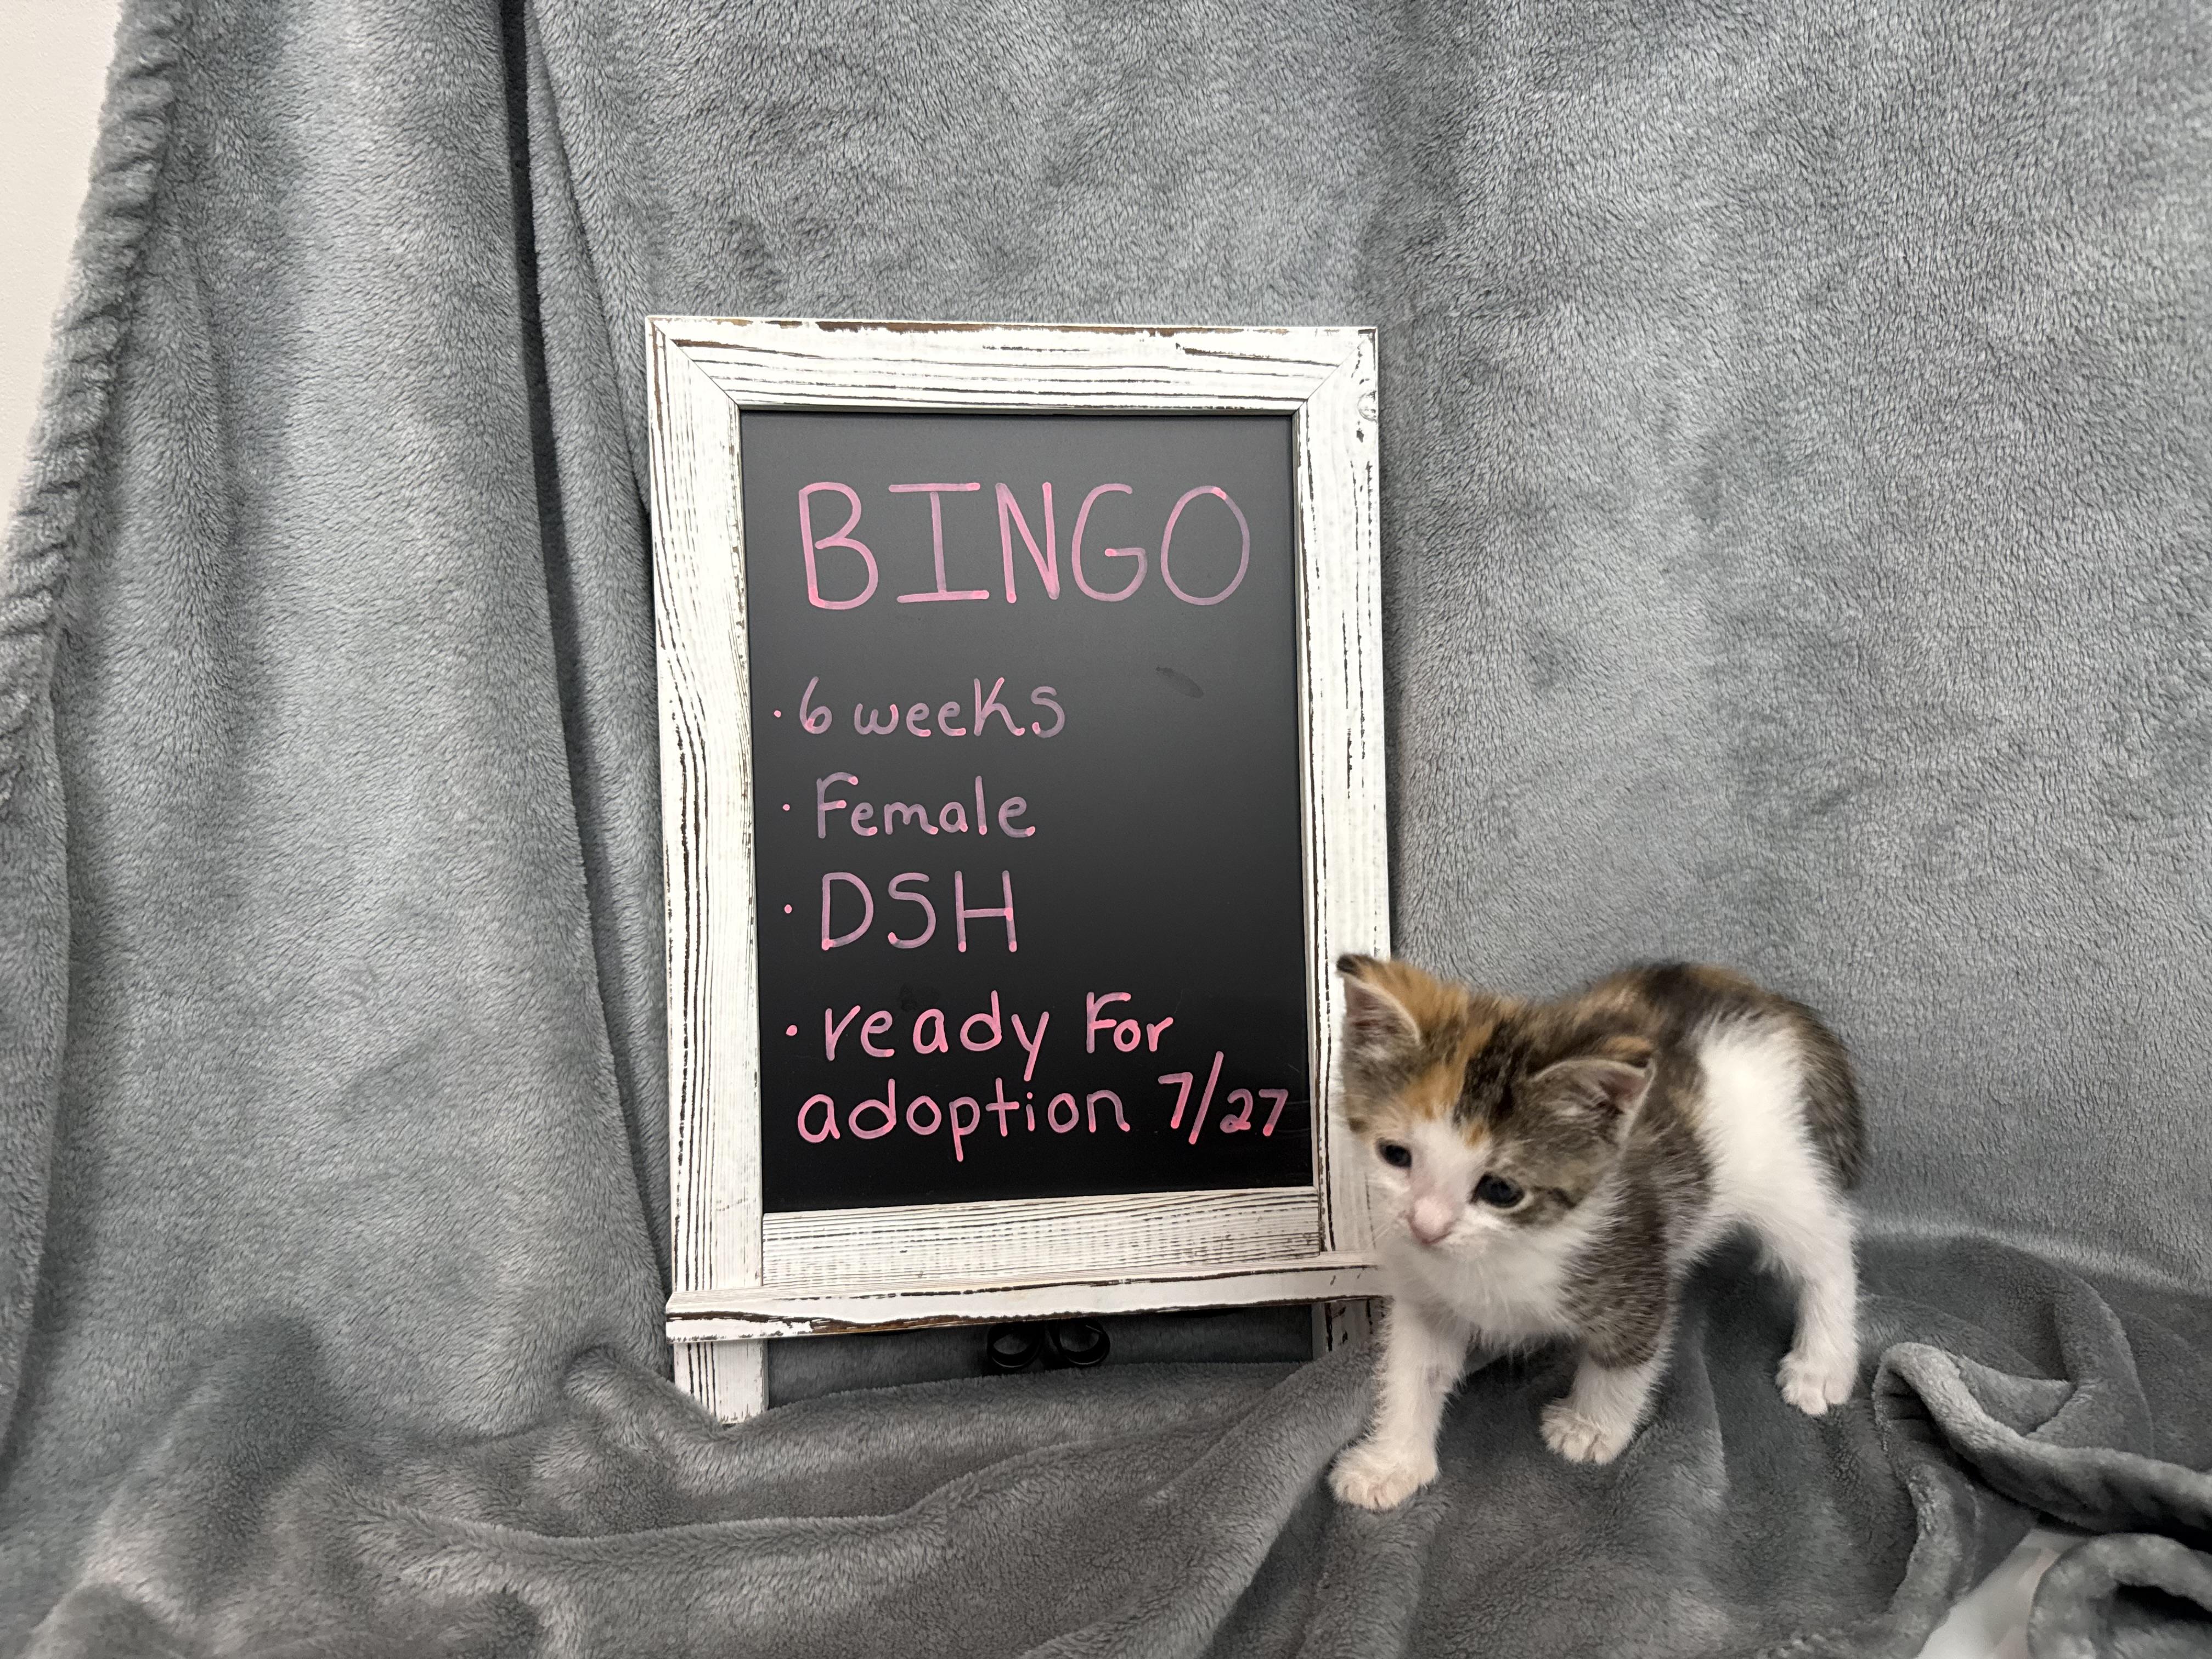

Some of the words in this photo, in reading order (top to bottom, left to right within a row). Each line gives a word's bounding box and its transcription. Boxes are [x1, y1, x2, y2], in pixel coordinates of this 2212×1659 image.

[799, 482, 1250, 610] BINGO
[799, 676, 832, 735] 6
[816, 772, 1036, 838] Female
[820, 870, 1018, 953] DSH
[824, 990, 1050, 1082] ready
[796, 1078, 1131, 1163] adoption
[1158, 1050, 1289, 1146] 7/27
